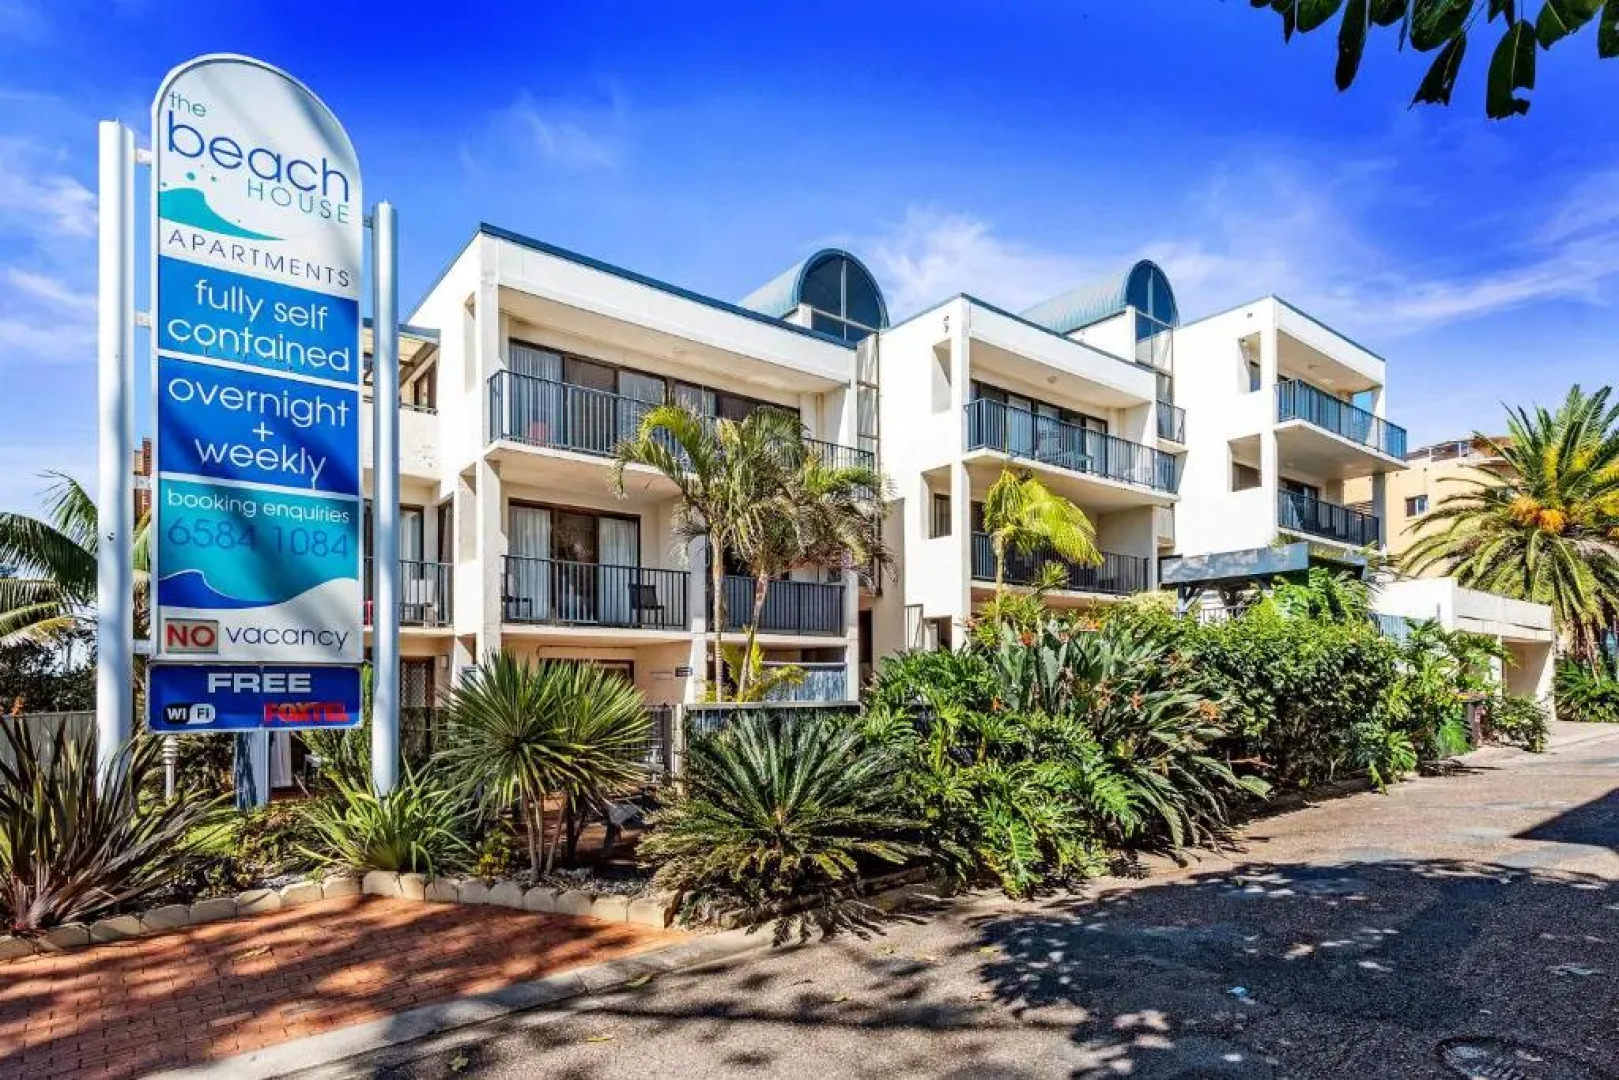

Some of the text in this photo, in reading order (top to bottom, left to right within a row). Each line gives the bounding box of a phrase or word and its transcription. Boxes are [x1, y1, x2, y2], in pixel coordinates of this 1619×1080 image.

[169, 91, 206, 118] the
[168, 110, 349, 203] beach
[247, 178, 349, 224] HOUSE
[168, 228, 350, 287] APARTMENTS
[194, 279, 328, 331] fully self
[167, 319, 350, 372] contained
[168, 378, 350, 428] overnight
[252, 421, 275, 442] +
[194, 438, 327, 490] weekly
[167, 489, 350, 524] booking enquiries
[167, 517, 349, 559] 6584 1084
[166, 624, 349, 650] NO vacancy
[207, 672, 312, 694] FREE
